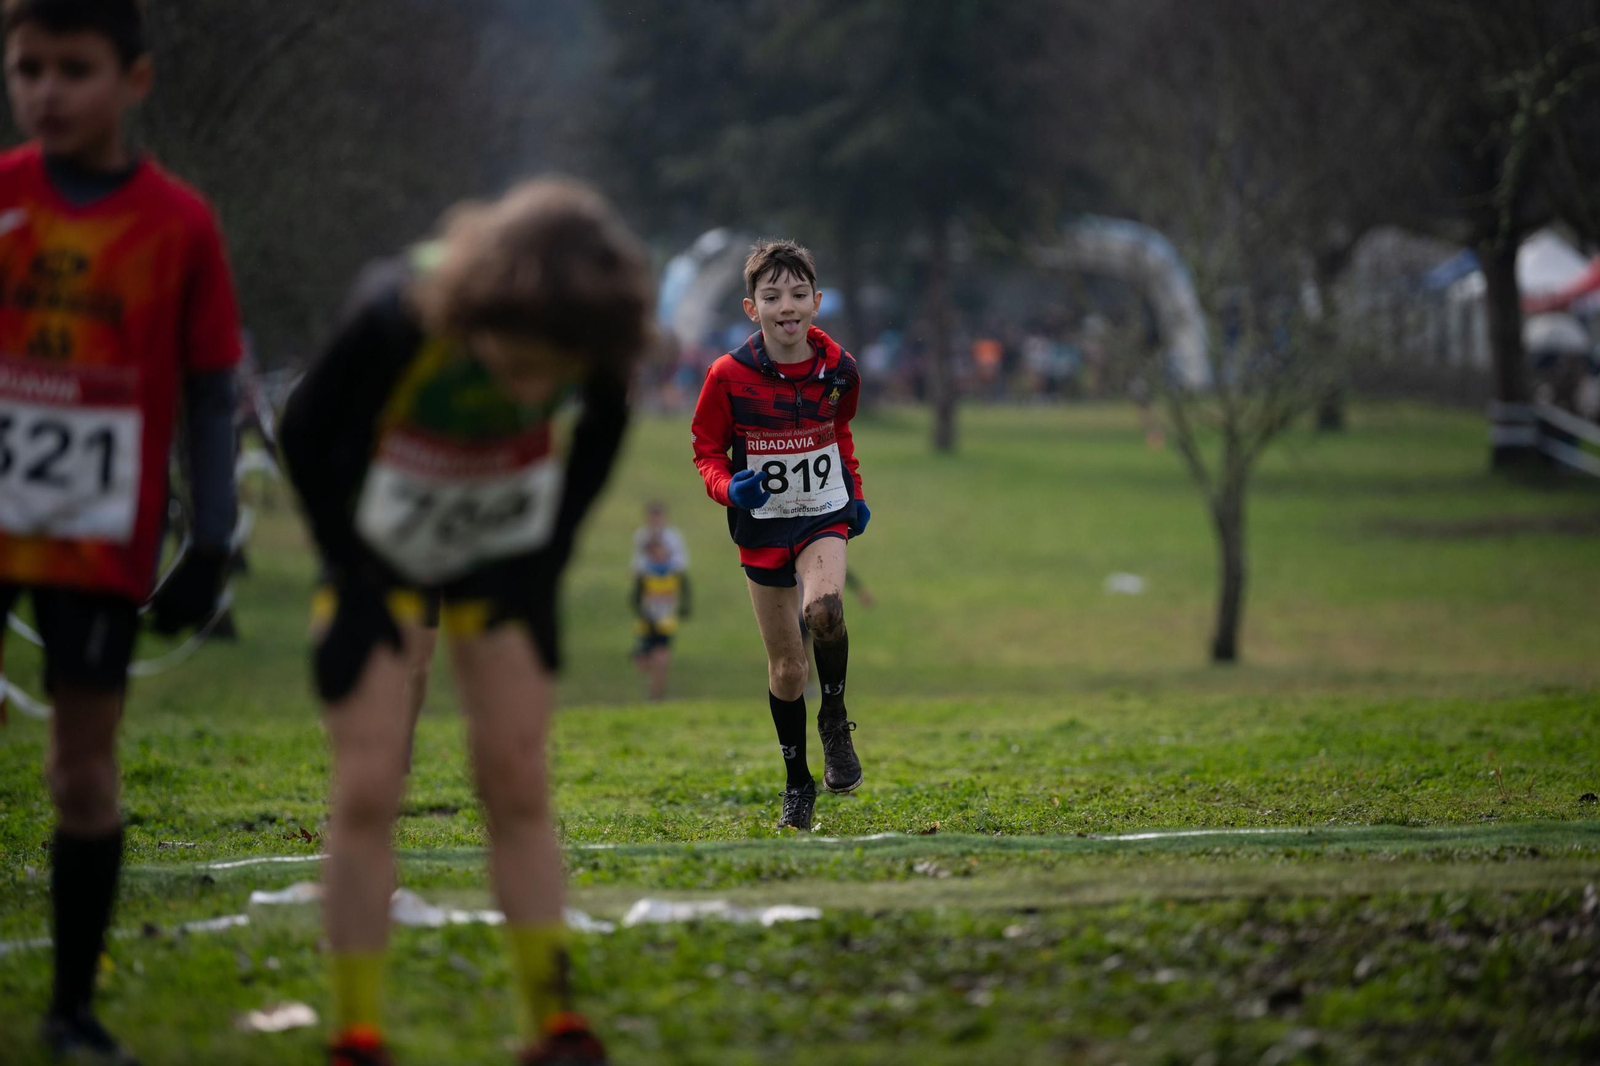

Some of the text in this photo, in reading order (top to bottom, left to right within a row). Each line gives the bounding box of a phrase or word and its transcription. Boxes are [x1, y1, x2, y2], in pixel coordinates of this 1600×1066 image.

[793, 427, 819, 436] Alejandro
[747, 437, 815, 450] RIBADAVIA
[761, 453, 831, 494] 819
